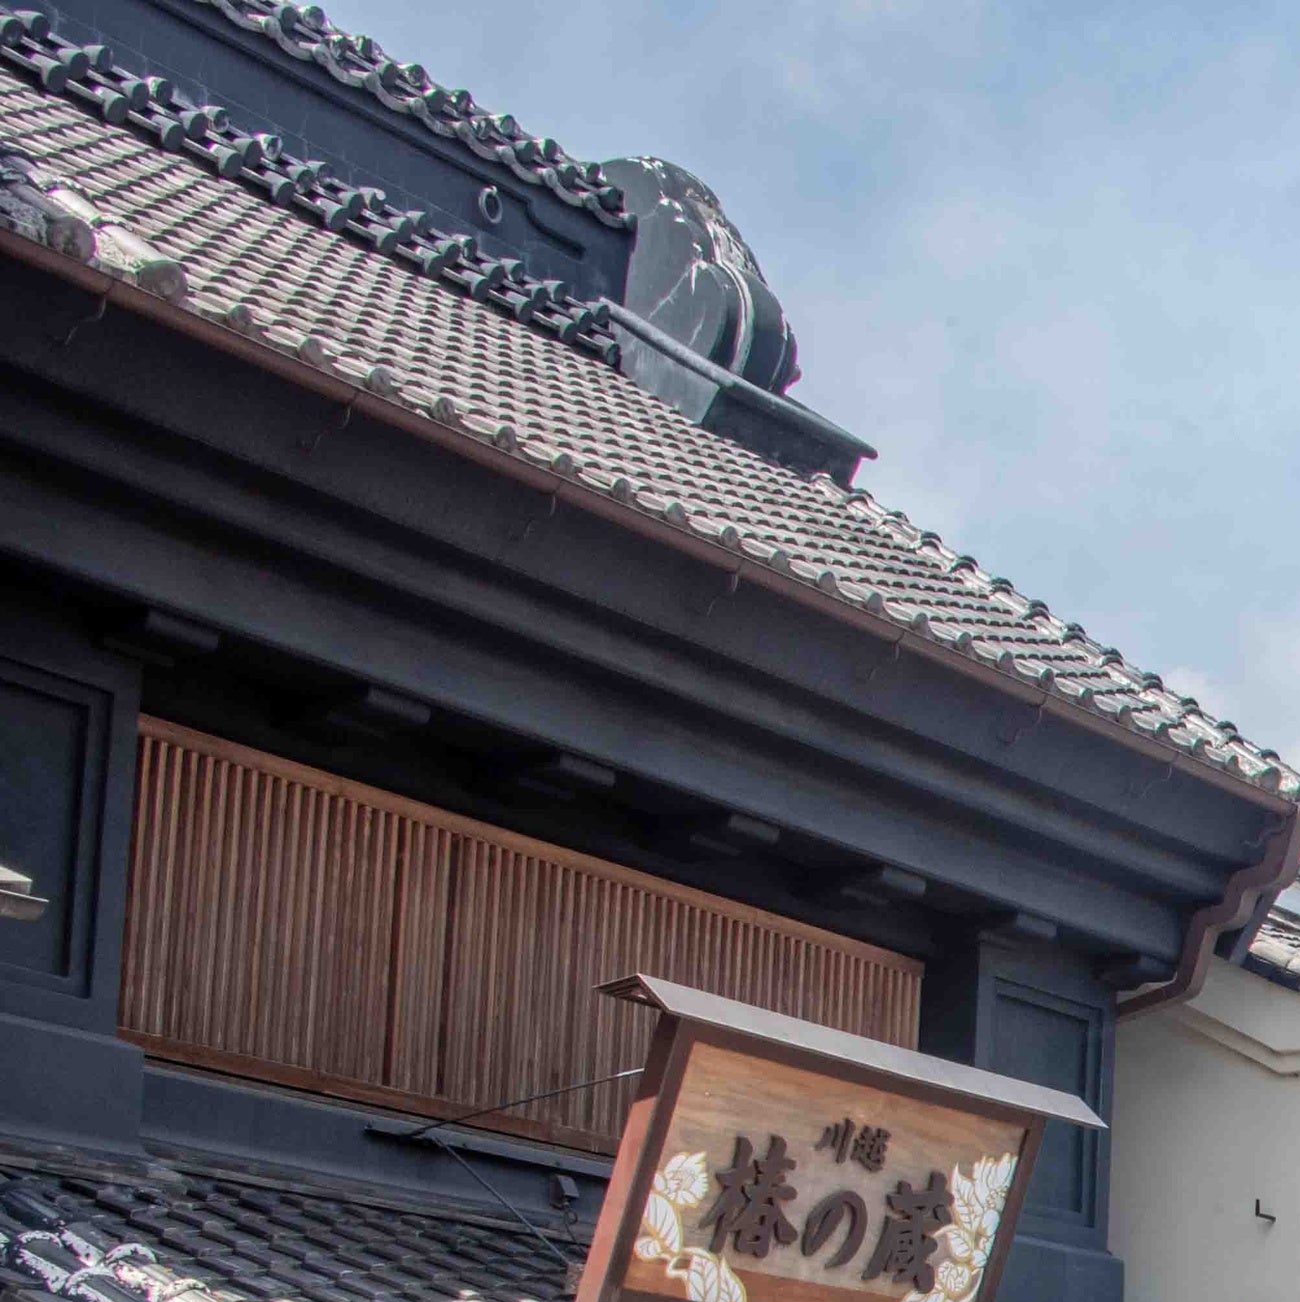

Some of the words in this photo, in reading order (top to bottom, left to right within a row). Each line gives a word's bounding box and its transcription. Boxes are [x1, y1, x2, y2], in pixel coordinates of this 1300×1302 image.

[814, 1117, 891, 1173] 川越
[700, 1133, 956, 1295] 椿の蔵
